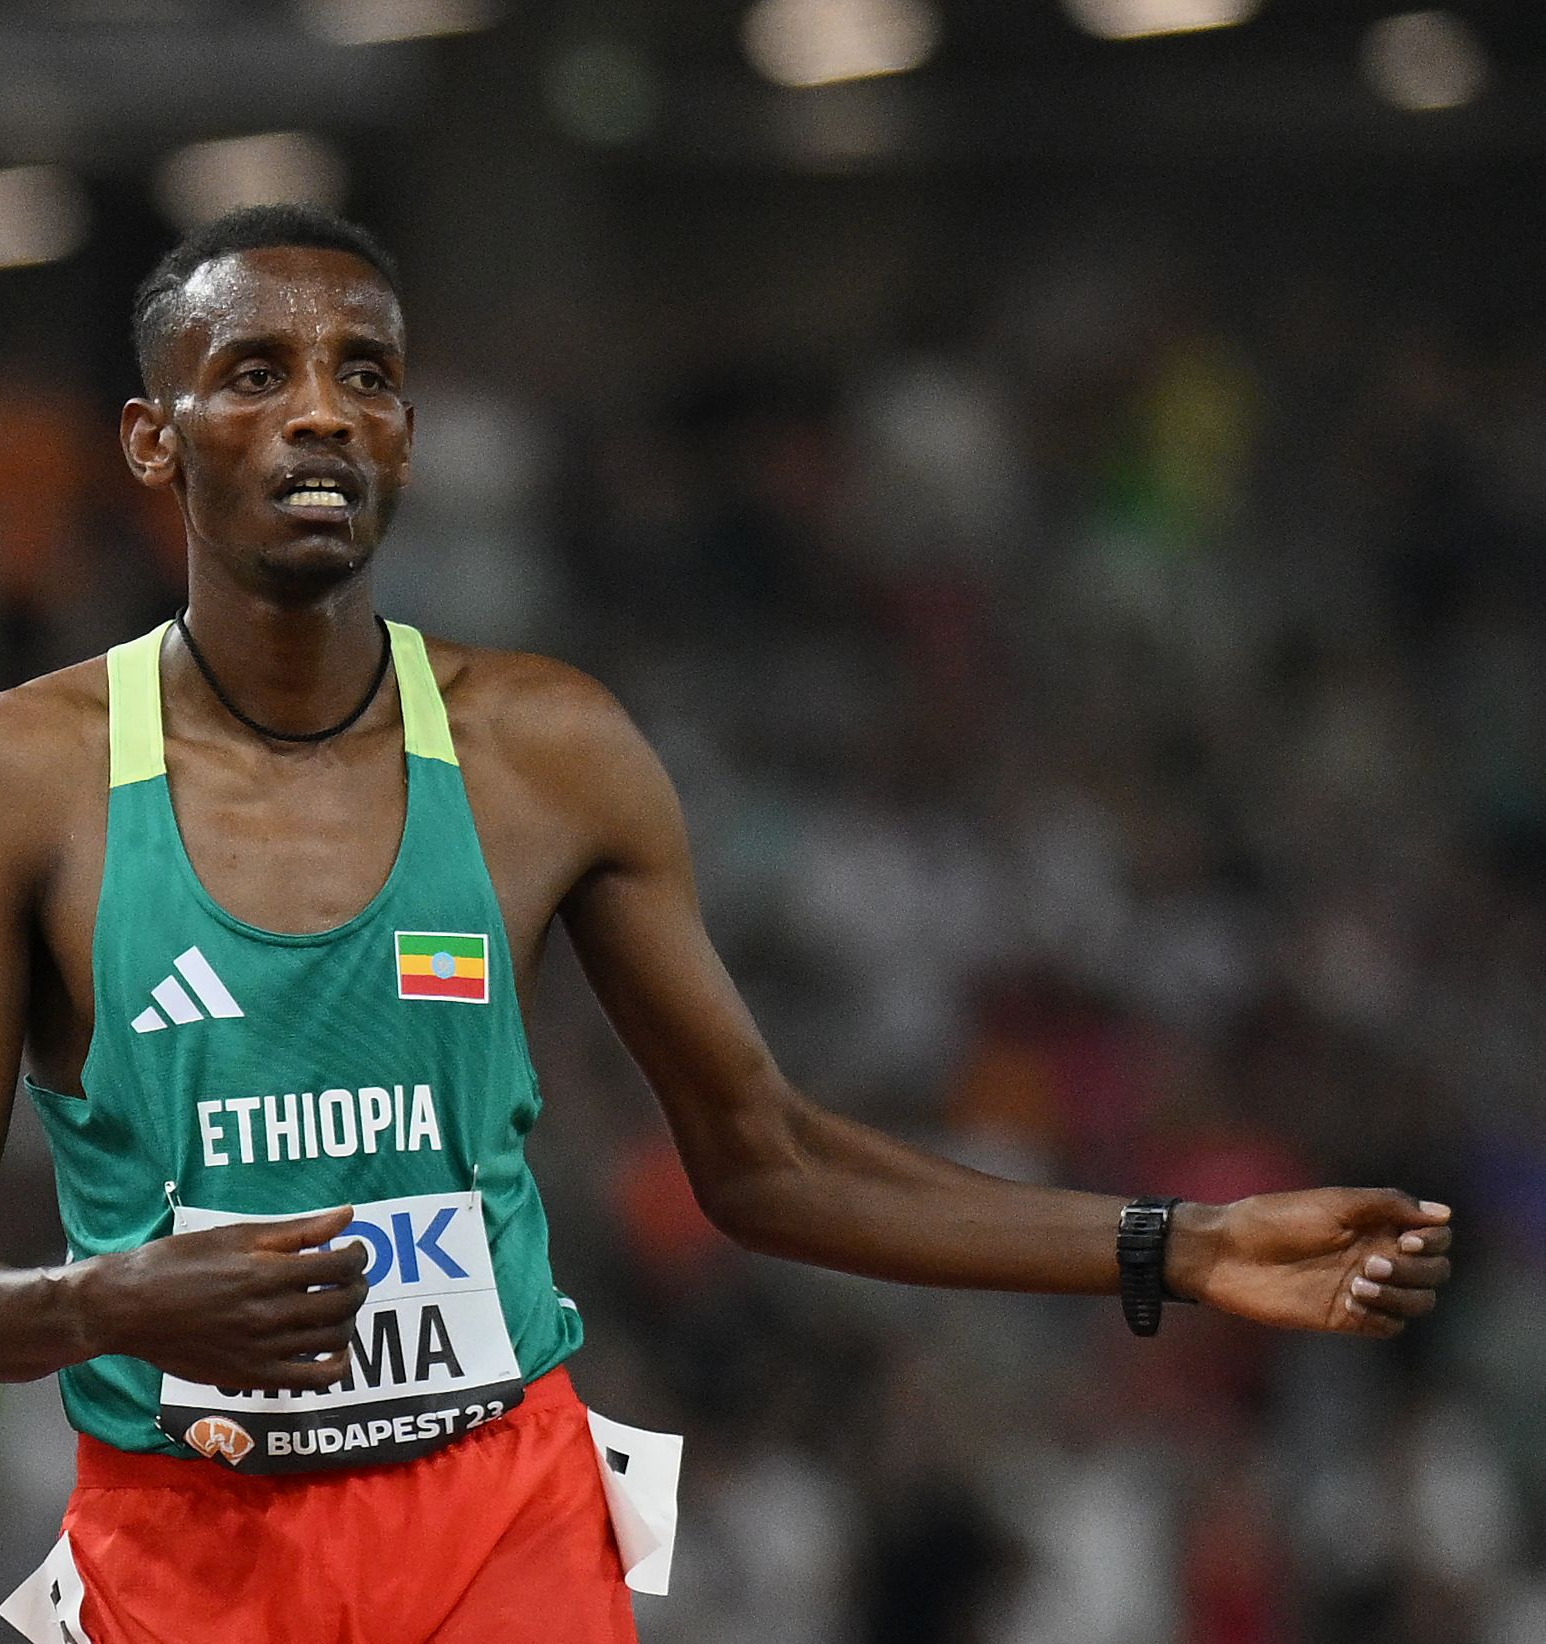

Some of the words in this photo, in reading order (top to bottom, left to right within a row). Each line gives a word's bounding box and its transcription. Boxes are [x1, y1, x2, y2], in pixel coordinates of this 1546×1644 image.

[197, 1084, 442, 1167] ETHIOPIA
[318, 1207, 470, 1288] DK
[267, 1408, 461, 1456] BUDAPEST
